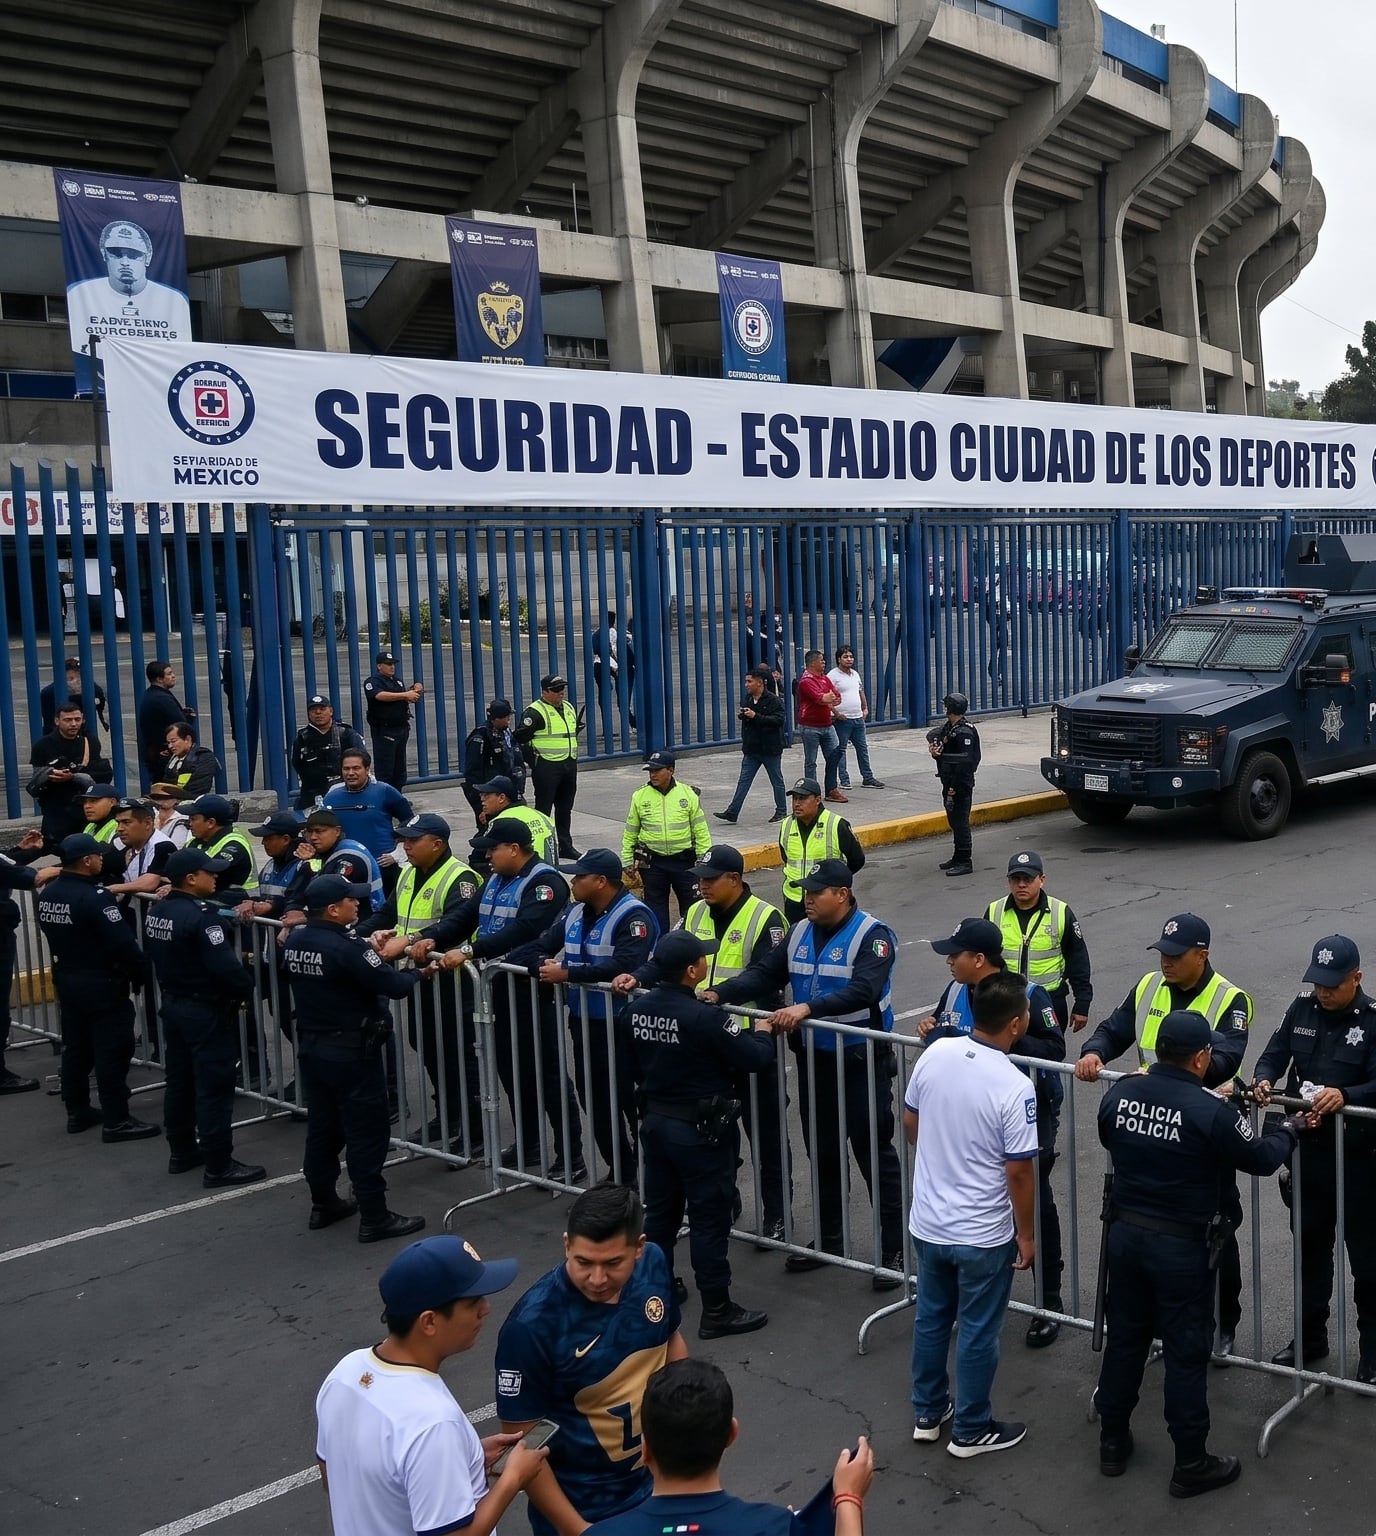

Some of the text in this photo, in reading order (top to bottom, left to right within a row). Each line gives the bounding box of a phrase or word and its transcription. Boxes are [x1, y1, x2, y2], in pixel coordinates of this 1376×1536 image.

[315, 389, 693, 475] SEGURIDAD
[741, 413, 937, 482] ESTADIO
[949, 423, 1096, 483] CIUDAD
[1106, 432, 1147, 484] DE
[1155, 435, 1212, 487] LOS
[1220, 438, 1356, 489] DEPORTES
[245, 457, 258, 467] DE
[173, 467, 260, 486] MEXICO
[633, 1027, 680, 1045] POLICIA
[1117, 1098, 1183, 1126] POLICIA
[1115, 1114, 1181, 1143] POLICIA
